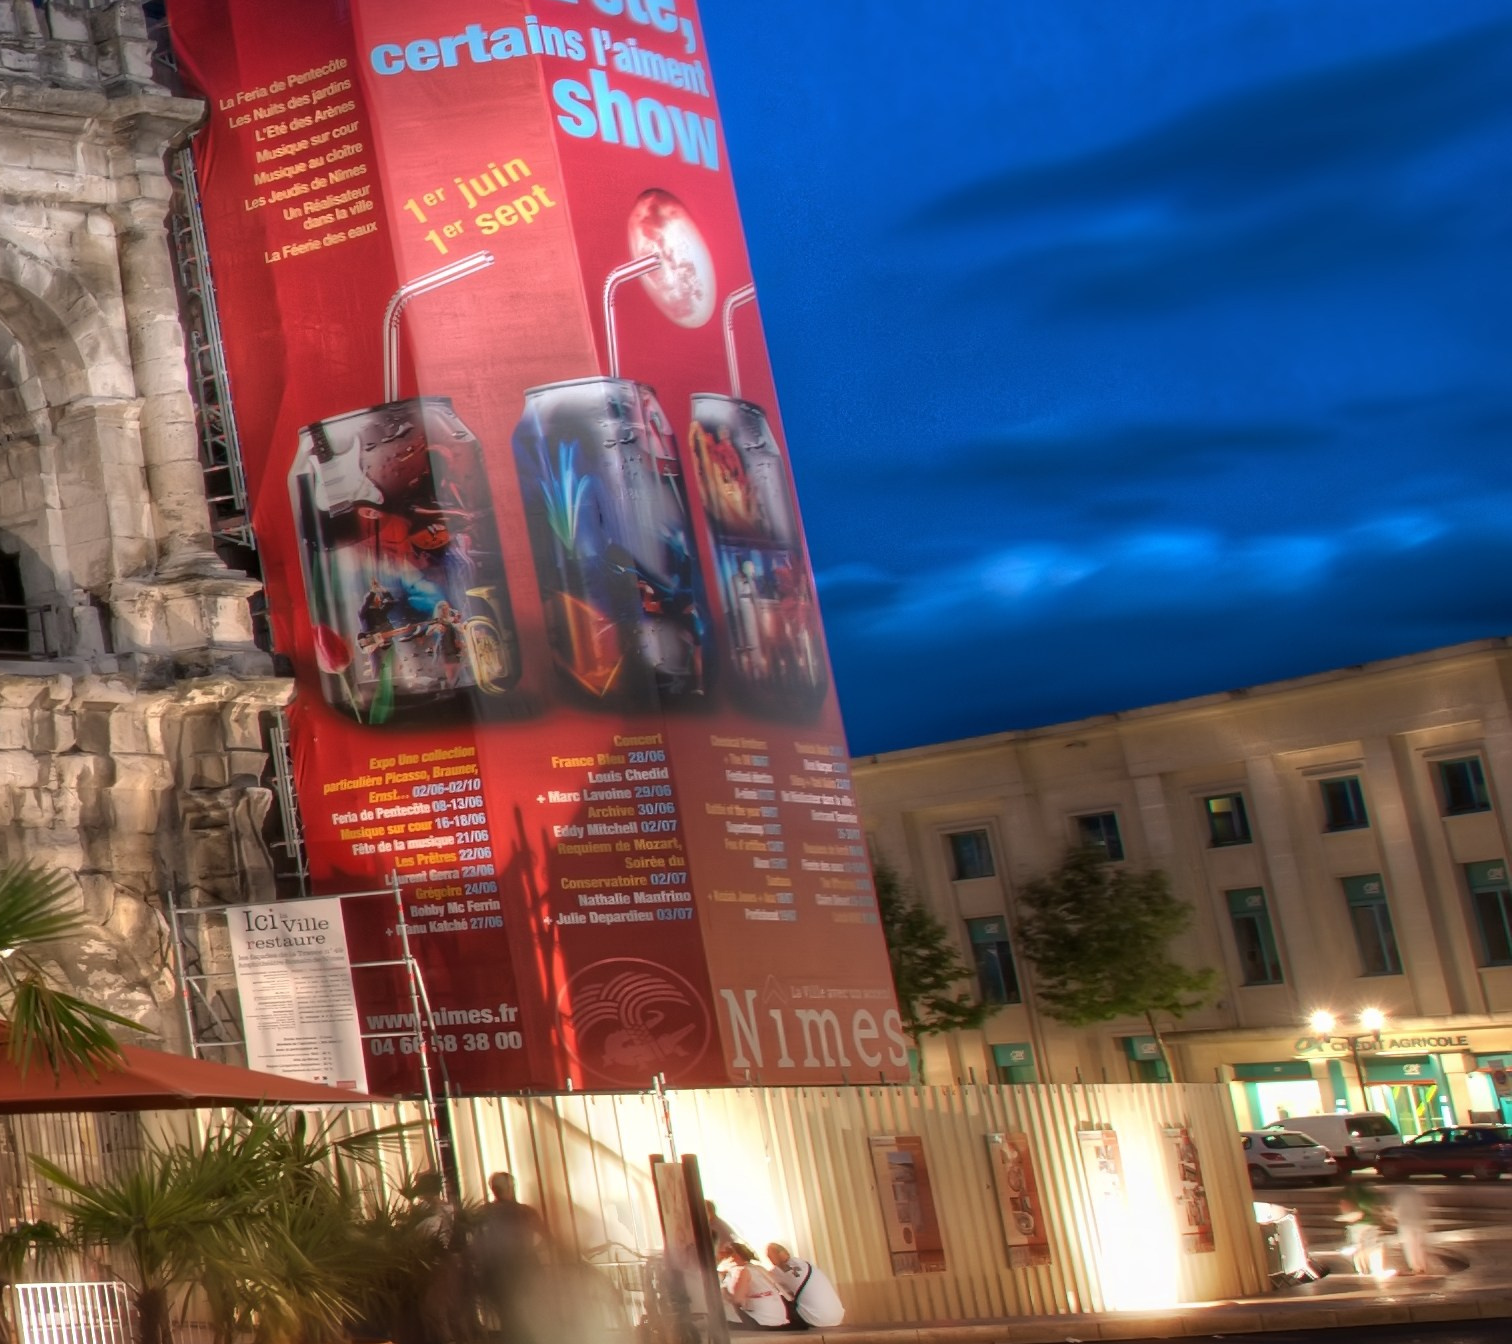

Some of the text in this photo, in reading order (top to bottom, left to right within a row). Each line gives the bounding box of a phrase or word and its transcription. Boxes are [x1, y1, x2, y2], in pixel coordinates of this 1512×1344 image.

[370, 14, 710, 98] certains l'aiment
[220, 57, 348, 111] La Feria de Pentecôte
[229, 78, 352, 129] Les Nuits des jardins
[289, 116, 314, 132] des
[315, 100, 356, 123] Arènes
[552, 68, 720, 172] show
[255, 120, 360, 164] Musique sur cour
[253, 142, 364, 186] Musique au cloître
[244, 195, 267, 211] Les
[267, 182, 311, 204] Jeudis
[310, 176, 329, 191] de
[282, 184, 371, 221] Un Réalisateur
[402, 157, 534, 225] 1er juin
[303, 199, 374, 231] dans la ville
[423, 182, 557, 256] 1er sept
[264, 251, 282, 264] La
[322, 231, 348, 247] des
[348, 220, 378, 239] eaux
[614, 733, 663, 748] Concert
[369, 745, 476, 771] Expo Une collection
[551, 749, 666, 769] France Bleu 28/06
[323, 775, 383, 796] particulière
[385, 769, 430, 785] Picasso,
[588, 767, 669, 784] Louis Chedid
[412, 778, 482, 798] 02/06-02/10
[548, 790, 581, 804] Marc
[583, 787, 633, 802] Lavoine
[634, 784, 672, 799] 29/06
[331, 812, 359, 826] Feria
[359, 809, 375, 822] de
[374, 802, 431, 820] Pentecôte
[588, 802, 676, 819] Archive 30/06
[340, 812, 487, 841] Musique sur cour 16-18/06
[553, 819, 677, 839] Eddy Mitchell 02/07
[351, 829, 490, 856] Fête de la musique 21/06
[557, 837, 683, 857] Requiem de Mozart,
[395, 846, 492, 868] Les Prêtres 22/06
[624, 854, 685, 870] Soirée du
[384, 864, 496, 886] Lurent Gerra 23/06
[561, 871, 687, 890] Conservatoire 02/07
[415, 881, 499, 901] Grégoire 24/06
[578, 892, 631, 907] Nathalie
[633, 889, 692, 905] Manfrino
[410, 898, 502, 918] Bobby Mc Ferrin
[556, 911, 587, 926] Julie
[589, 907, 654, 926] Depardieu
[656, 907, 694, 921] 03/07
[242, 908, 279, 932] Ici
[281, 917, 329, 933] Ville
[429, 918, 469, 933] Katché
[470, 915, 504, 930] 27/06
[247, 934, 326, 950] restaure
[370, 1037, 396, 1057] 04
[463, 1032, 491, 1052] 38
[494, 1031, 523, 1050] 00
[1388, 1035, 1469, 1050] AGRICOLE
